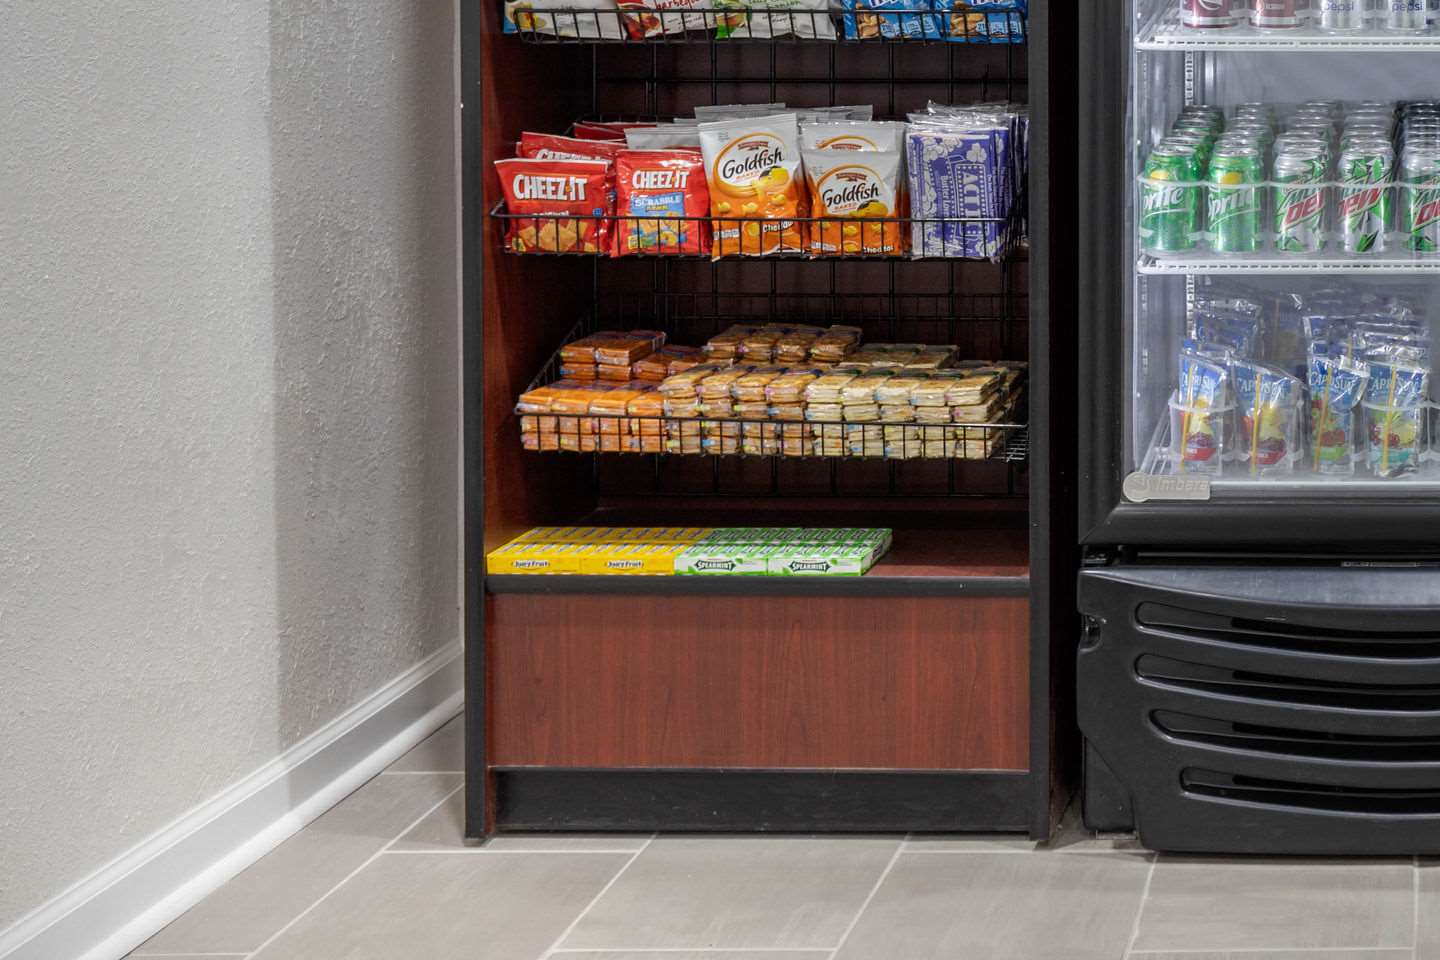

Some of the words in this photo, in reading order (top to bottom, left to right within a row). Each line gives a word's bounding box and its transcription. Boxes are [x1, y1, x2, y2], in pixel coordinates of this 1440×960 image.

[722, 146, 784, 180] Goldfish
[822, 182, 879, 208] Goldfish
[962, 172, 981, 208] ACT
